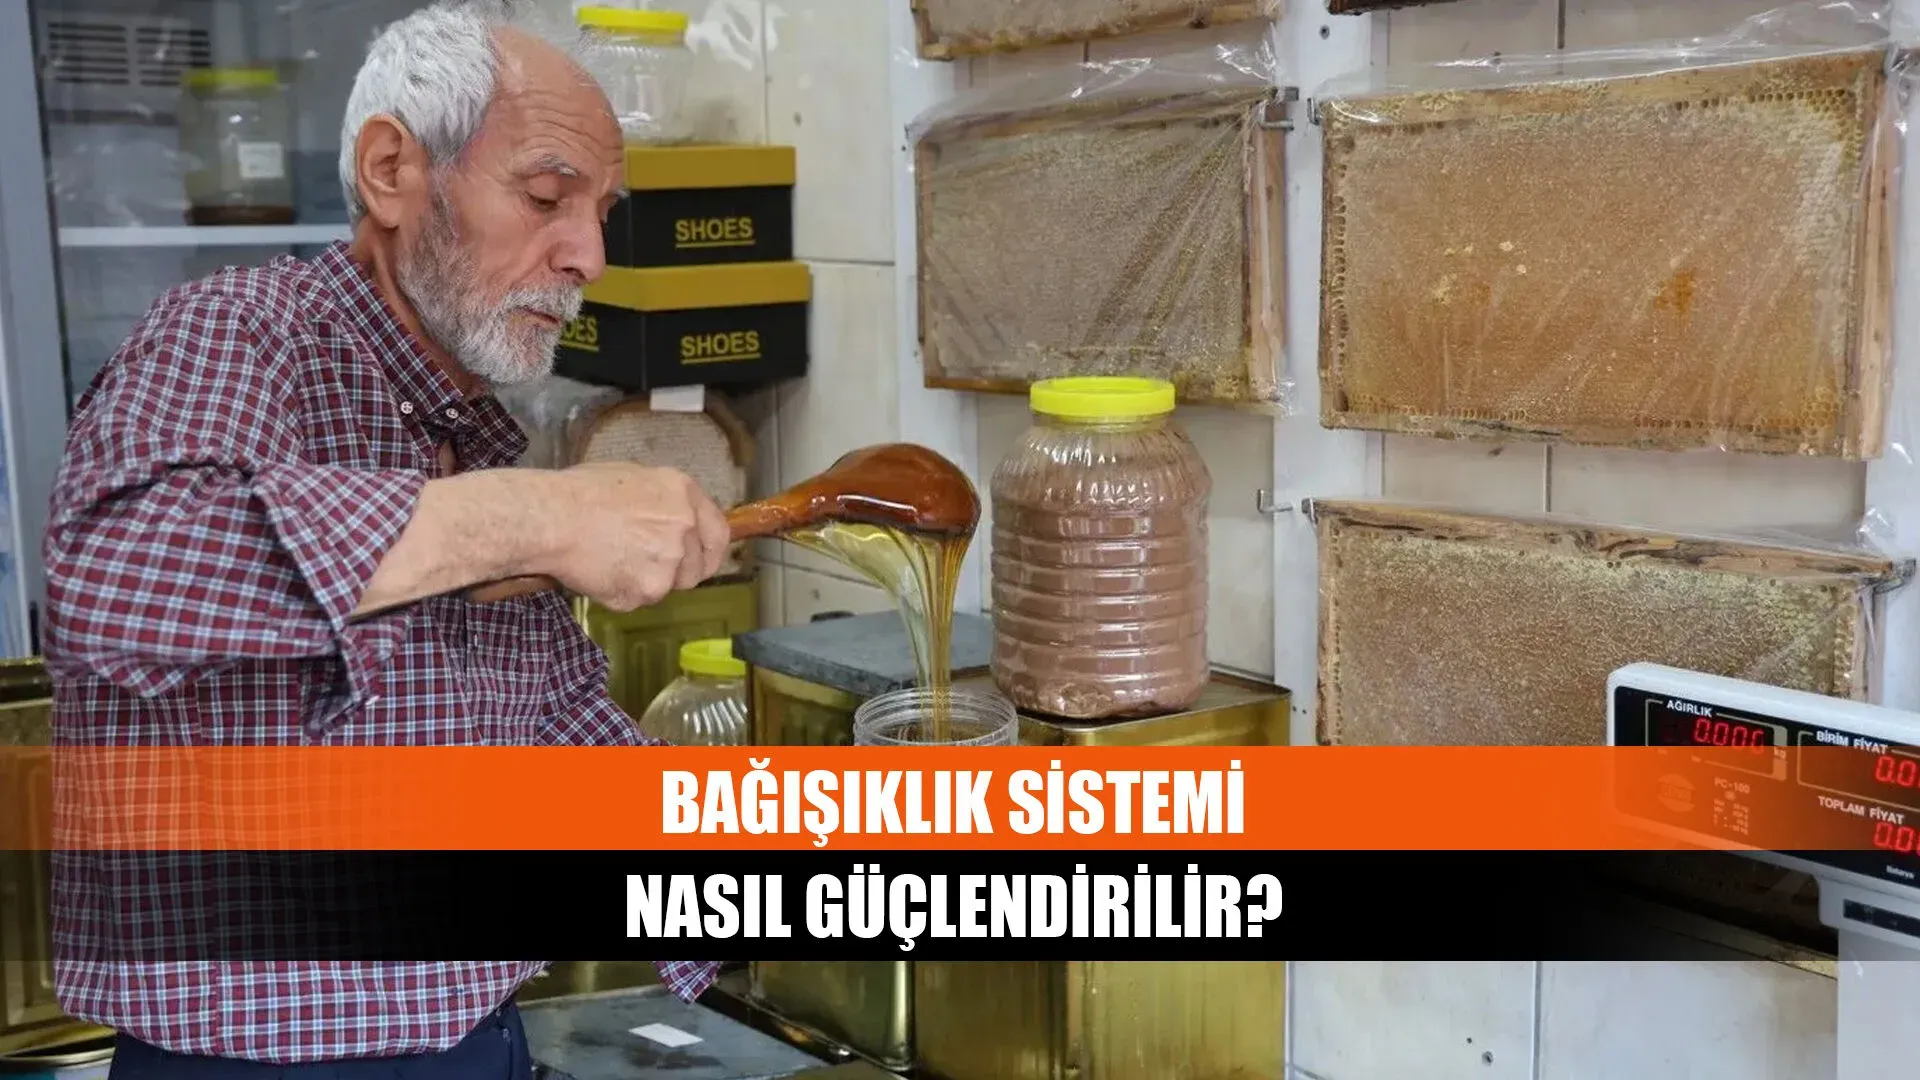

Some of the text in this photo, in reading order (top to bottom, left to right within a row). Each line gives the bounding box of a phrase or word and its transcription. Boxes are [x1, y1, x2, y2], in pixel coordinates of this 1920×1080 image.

[675, 217, 754, 242] SHOES
[563, 315, 597, 344] OES
[680, 331, 760, 358] SHOES
[1666, 700, 1713, 718] AĞIRLIK
[1816, 730, 1888, 755] BİRİM FİYAT
[1875, 755, 1920, 788] 0.0
[1818, 795, 1905, 825] TOPLAM FİYAT
